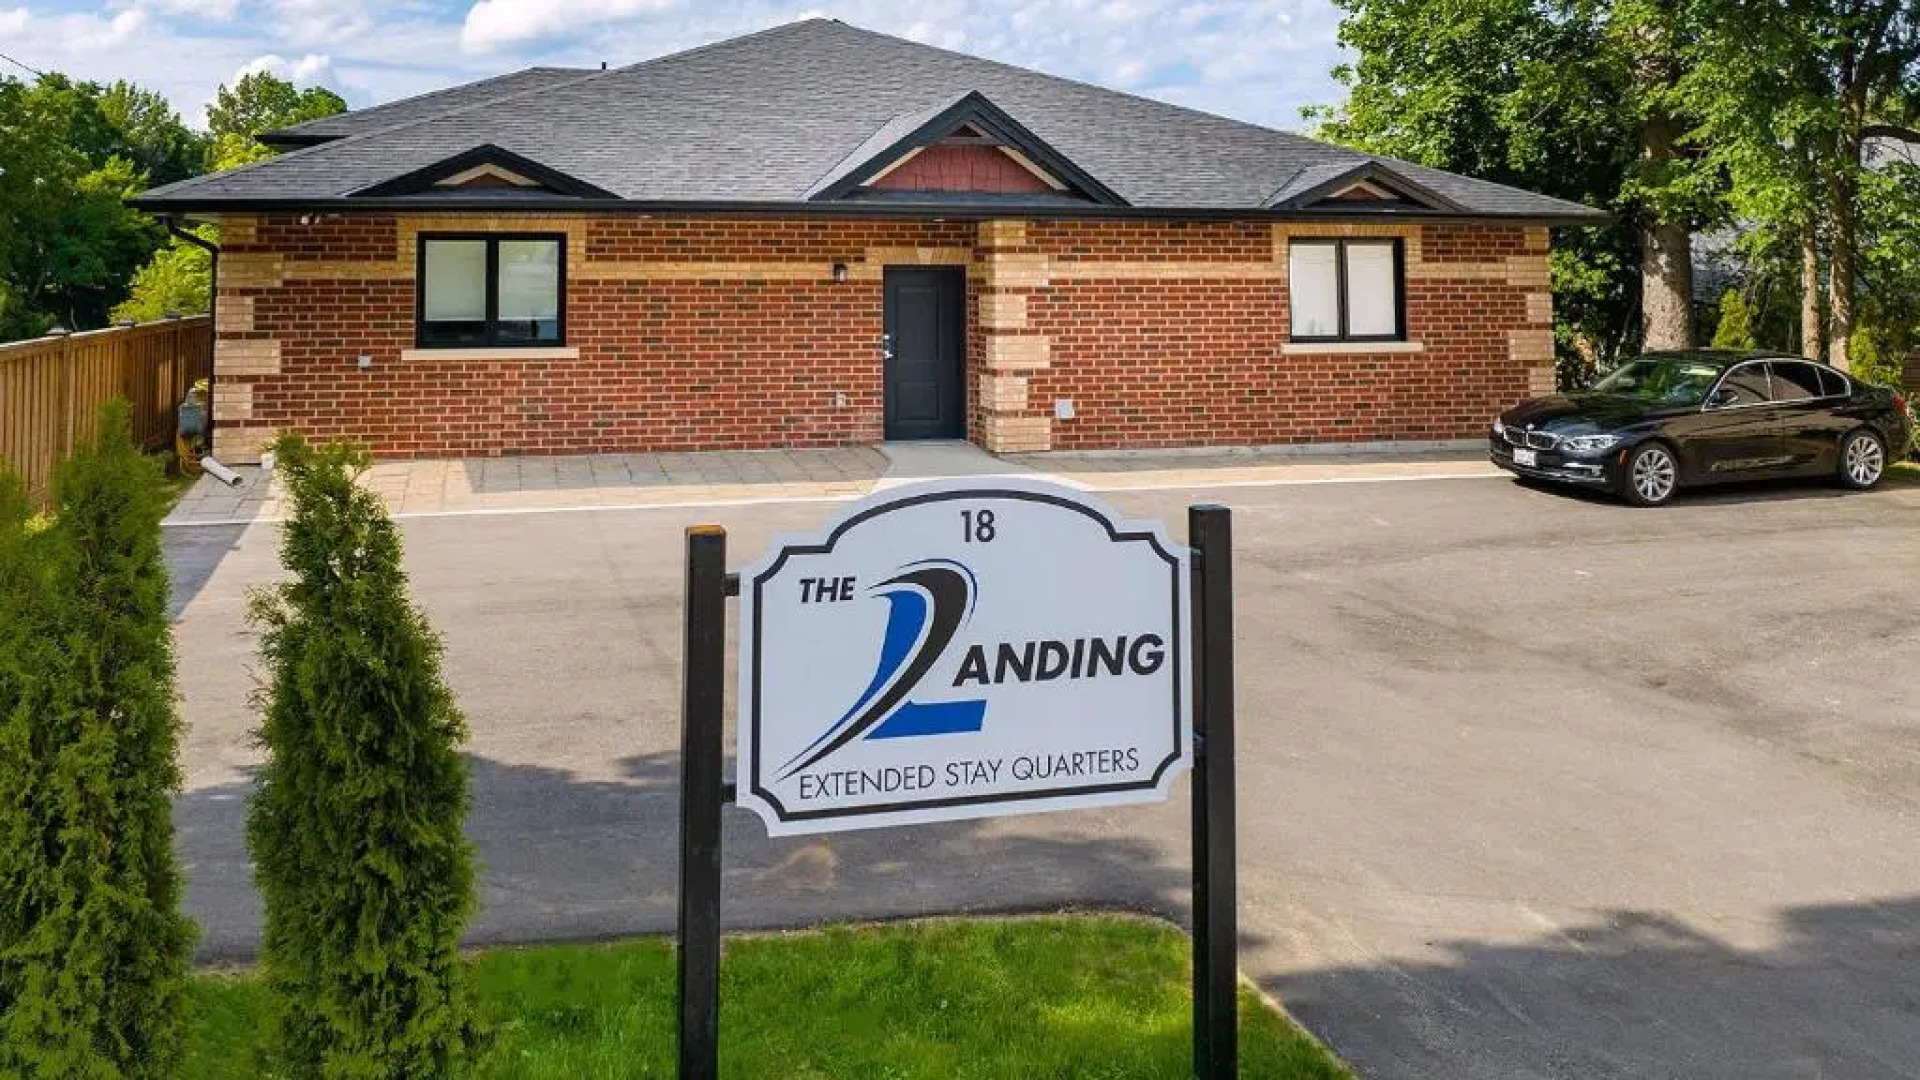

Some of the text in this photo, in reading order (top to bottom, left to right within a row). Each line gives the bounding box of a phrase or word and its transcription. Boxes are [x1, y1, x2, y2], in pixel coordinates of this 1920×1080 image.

[960, 509, 996, 543] 18
[799, 576, 856, 603] THE
[799, 747, 1140, 800] EXTENDED STAY QUARTERS
